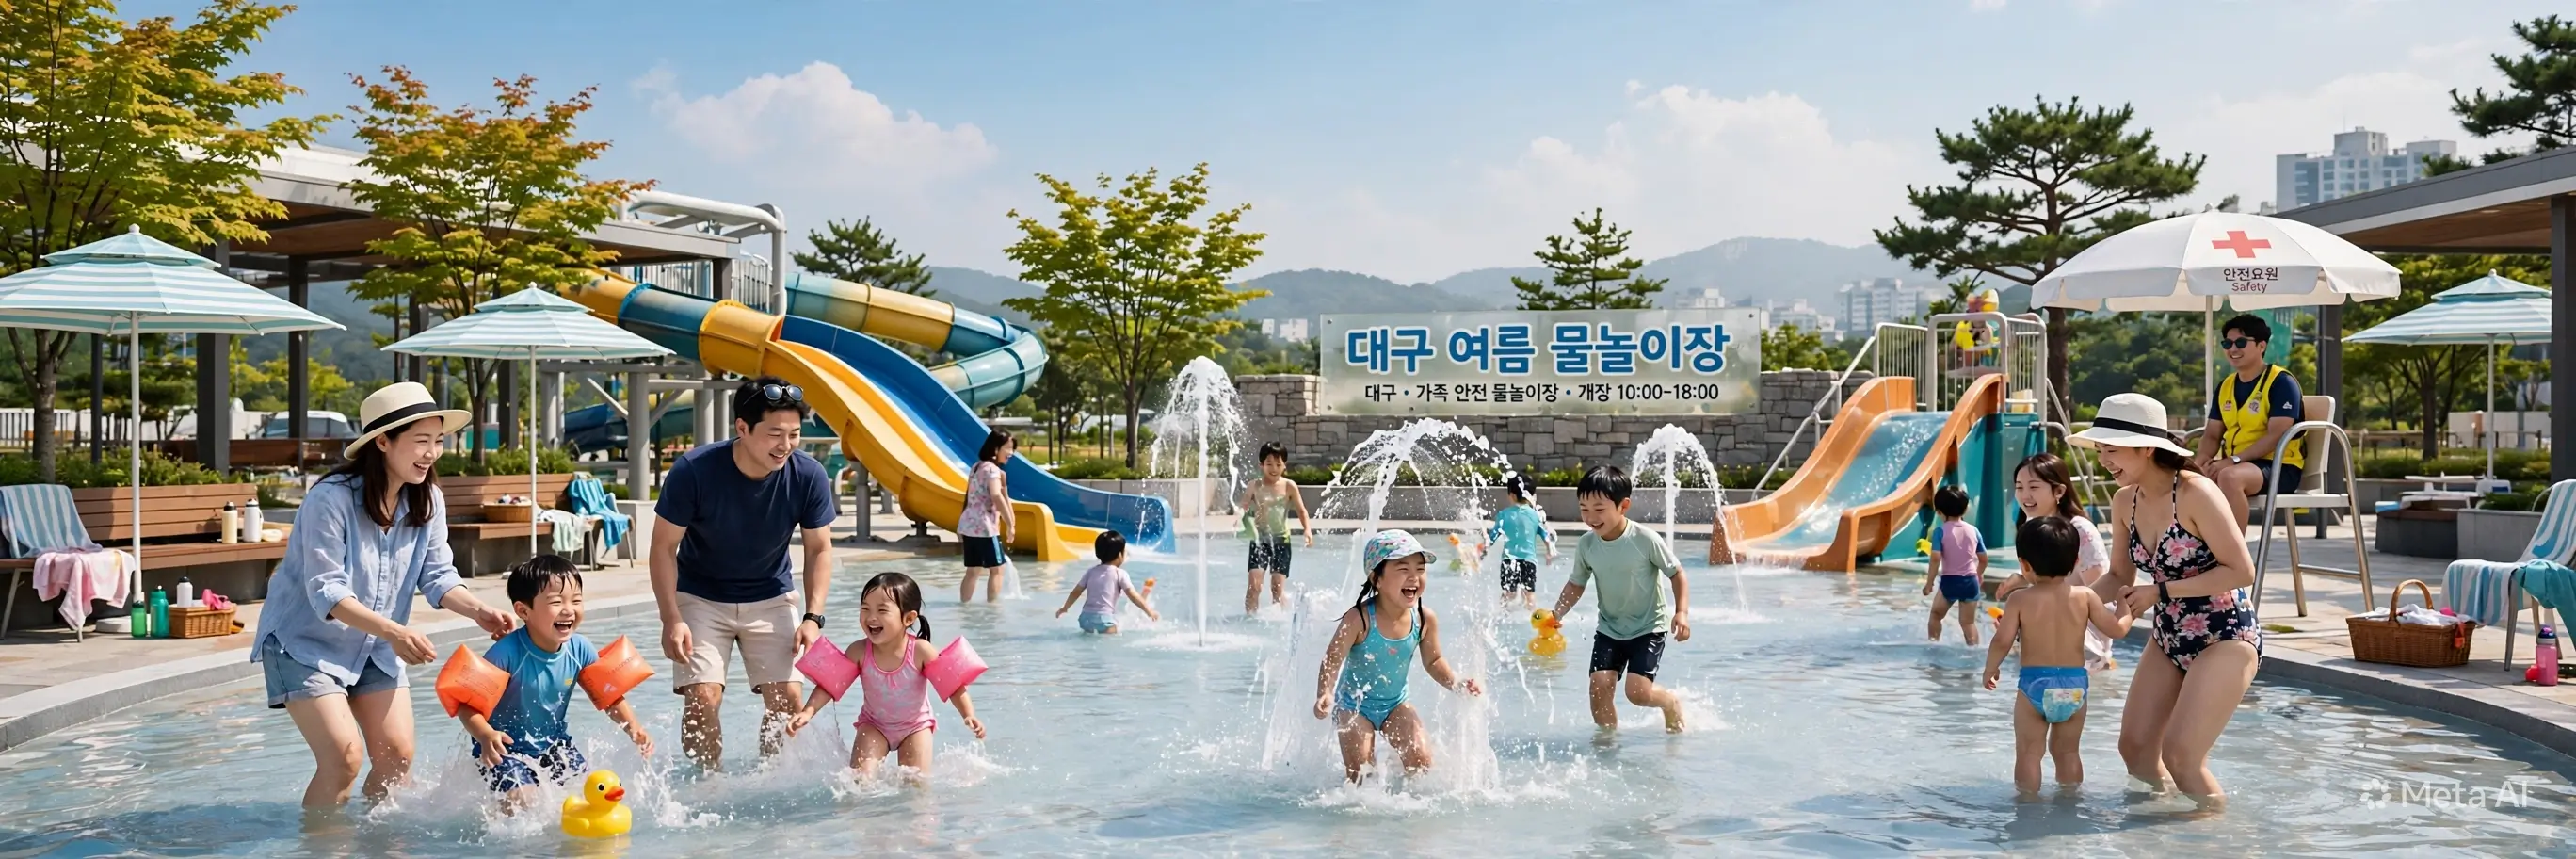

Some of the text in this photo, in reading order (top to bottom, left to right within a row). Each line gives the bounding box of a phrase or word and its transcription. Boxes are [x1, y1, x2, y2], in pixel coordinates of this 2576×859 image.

[2223, 267, 2278, 282] 안전요원
[2231, 282, 2268, 294] Safety
[1347, 325, 1730, 374] 대구 여름 물놀이장
[1364, 382, 1719, 403] 대구 가족 안전 물놀이장 개장 10:00-18:00
